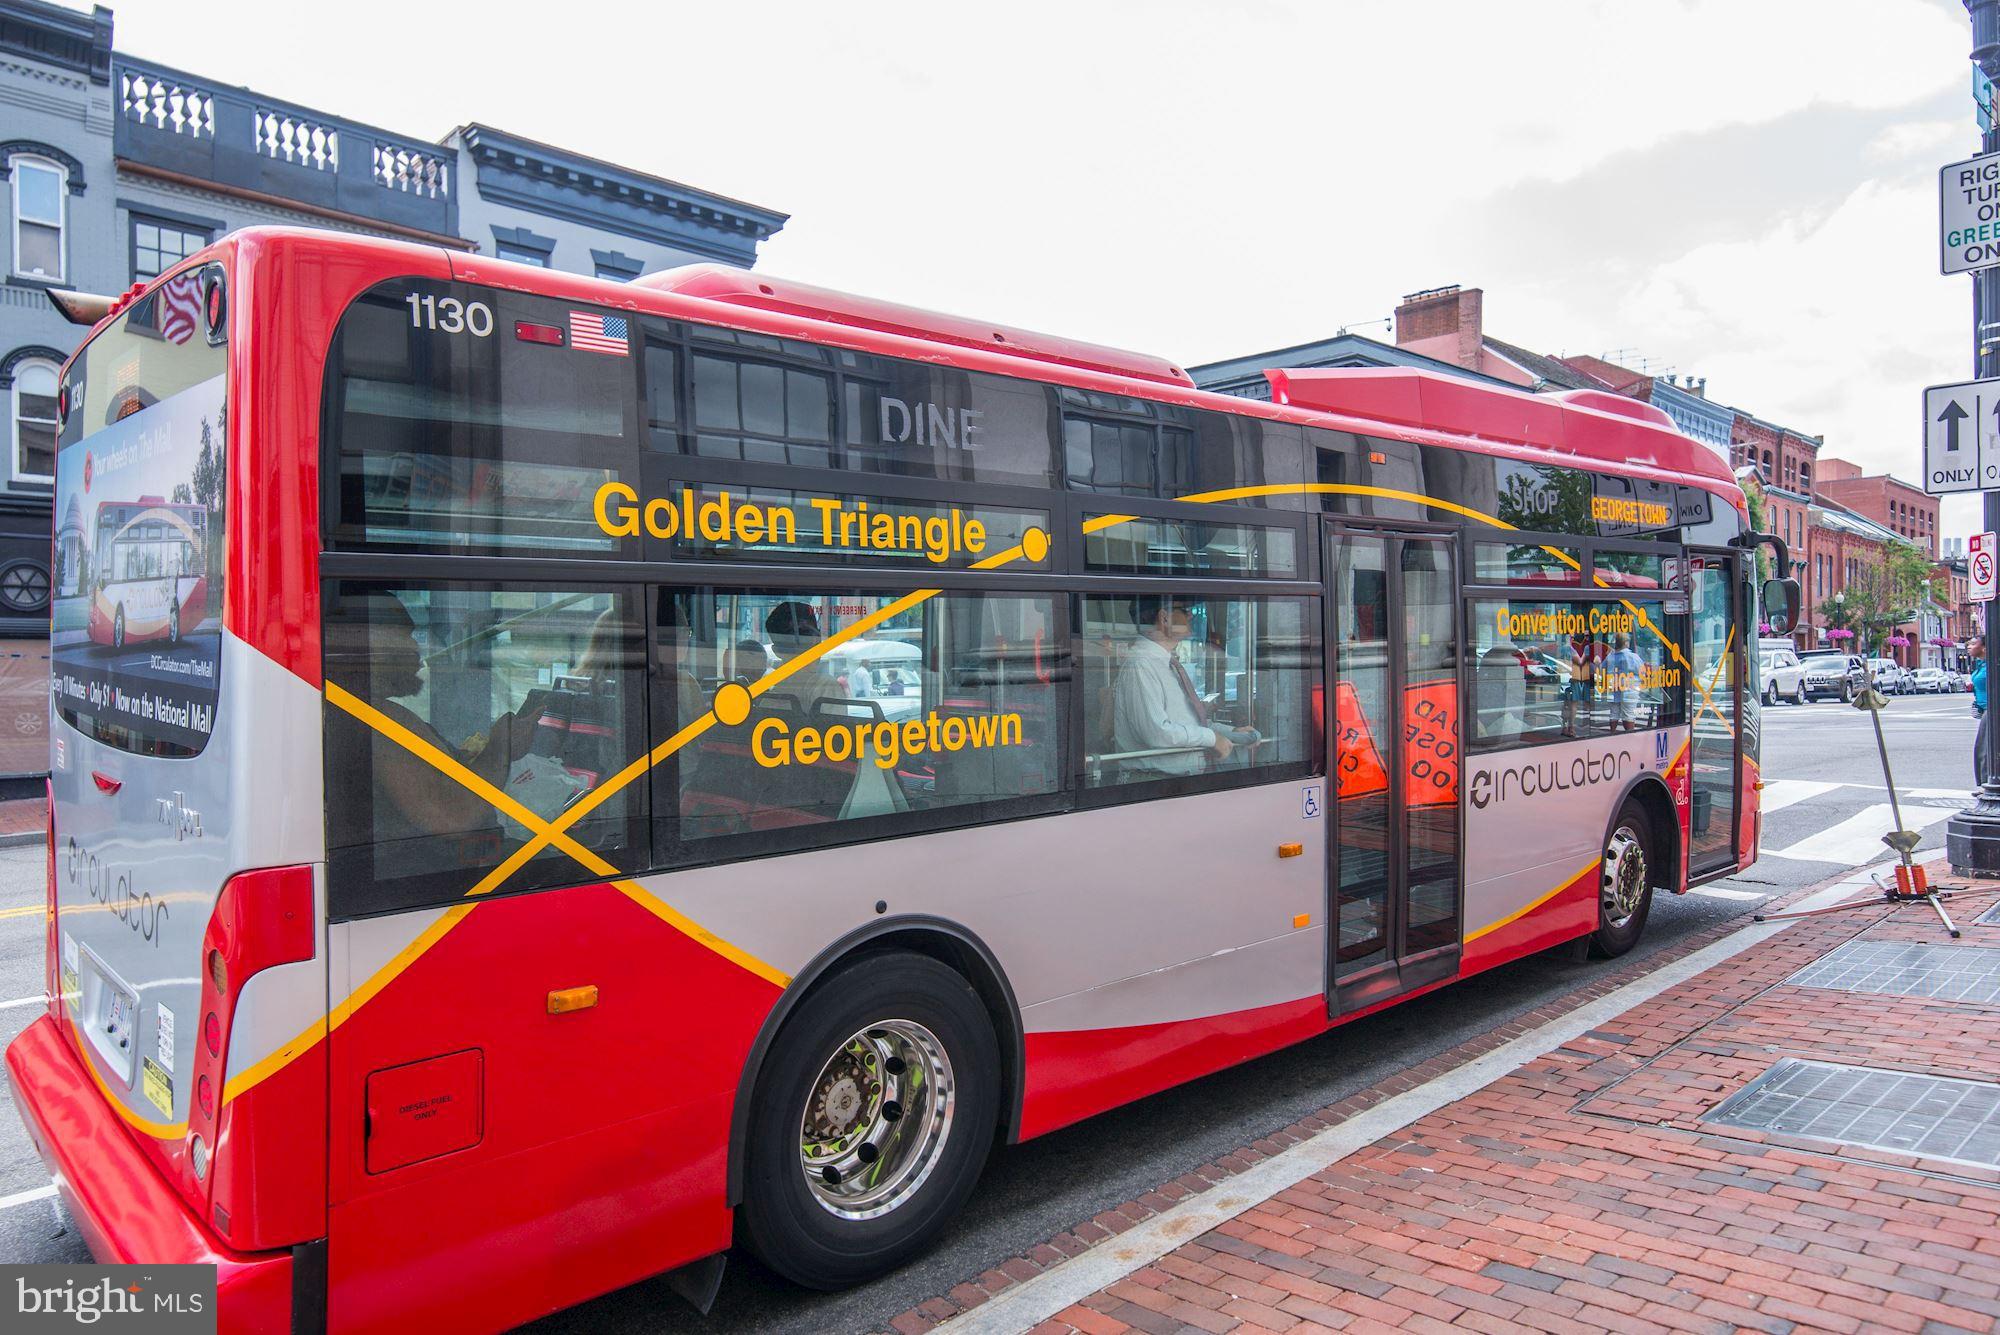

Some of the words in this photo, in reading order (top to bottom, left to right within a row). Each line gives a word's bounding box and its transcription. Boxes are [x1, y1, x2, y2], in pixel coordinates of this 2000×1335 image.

[406, 293, 493, 336] 1130
[71, 381, 83, 412] 1130
[881, 396, 984, 450] DINE
[1933, 468, 1974, 484] ONLY
[1986, 466, 2000, 479] O
[1512, 483, 1558, 514] SHOP
[1591, 497, 1667, 525] GEORGETOWN
[593, 481, 796, 544] Golden
[811, 498, 986, 563] Triangle
[1497, 608, 1585, 636] Convention
[1589, 608, 1634, 634] Center
[1596, 667, 1634, 694] Union
[1639, 664, 1680, 689] Station
[69, 676, 86, 700] Minutes
[90, 680, 102, 710] Only
[103, 684, 110, 707] $1
[115, 687, 130, 713] Now
[131, 696, 140, 715] on
[142, 692, 153, 719] the
[155, 695, 189, 728] National
[191, 703, 212, 734] Mall
[752, 711, 1022, 769] Georgetown
[1656, 732, 1667, 759] M
[400, 1100, 429, 1114] DIESEL
[414, 1109, 437, 1120] ONLY
